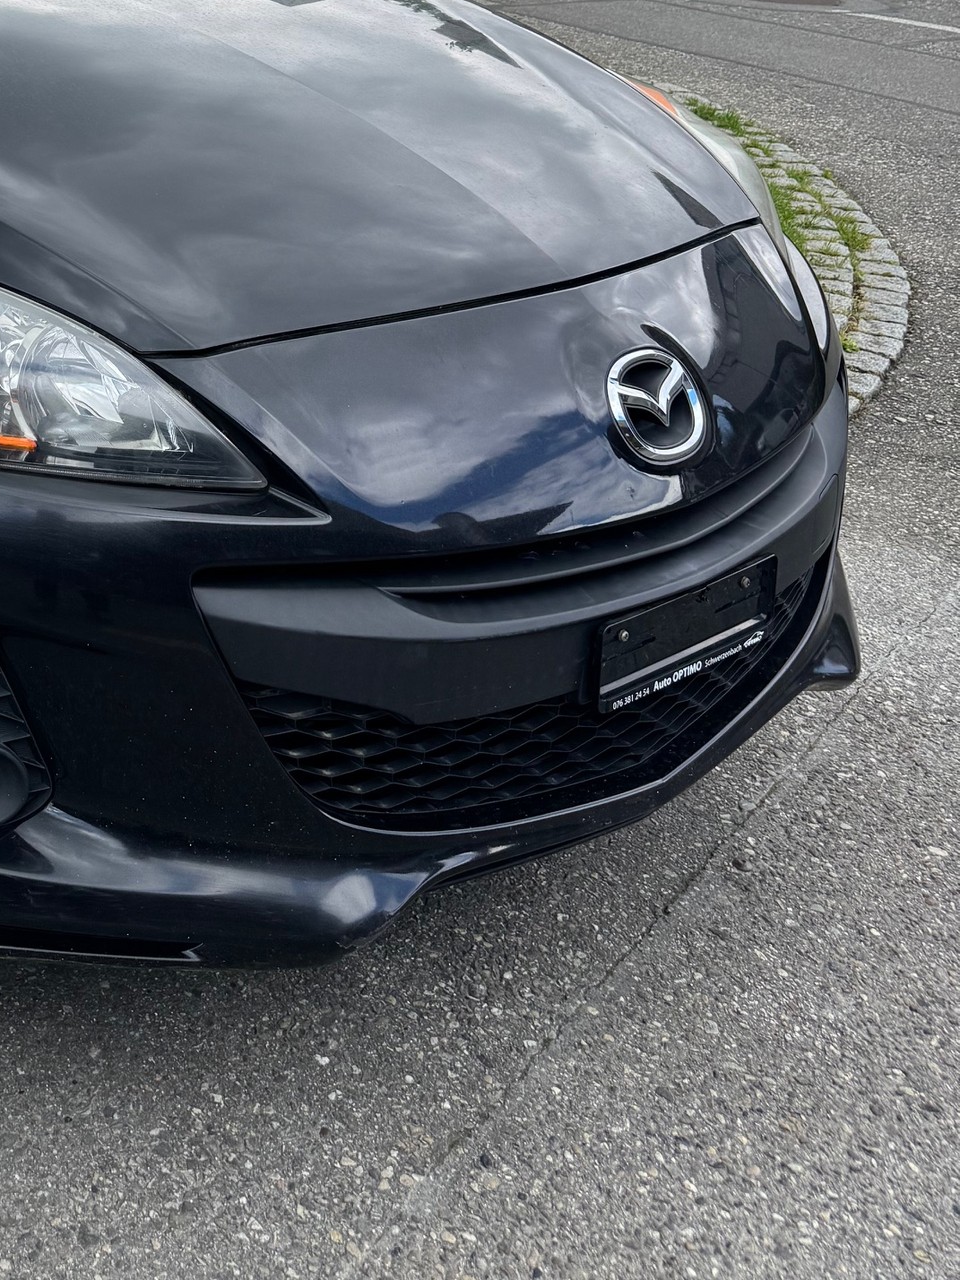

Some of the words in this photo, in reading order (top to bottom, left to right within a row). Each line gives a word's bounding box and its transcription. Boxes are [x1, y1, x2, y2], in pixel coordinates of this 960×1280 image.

[612, 698, 623, 710] 076
[624, 694, 634, 706] 381
[635, 690, 642, 701] 24
[653, 677, 672, 692] Auto
[672, 660, 702, 682] OPTIMO
